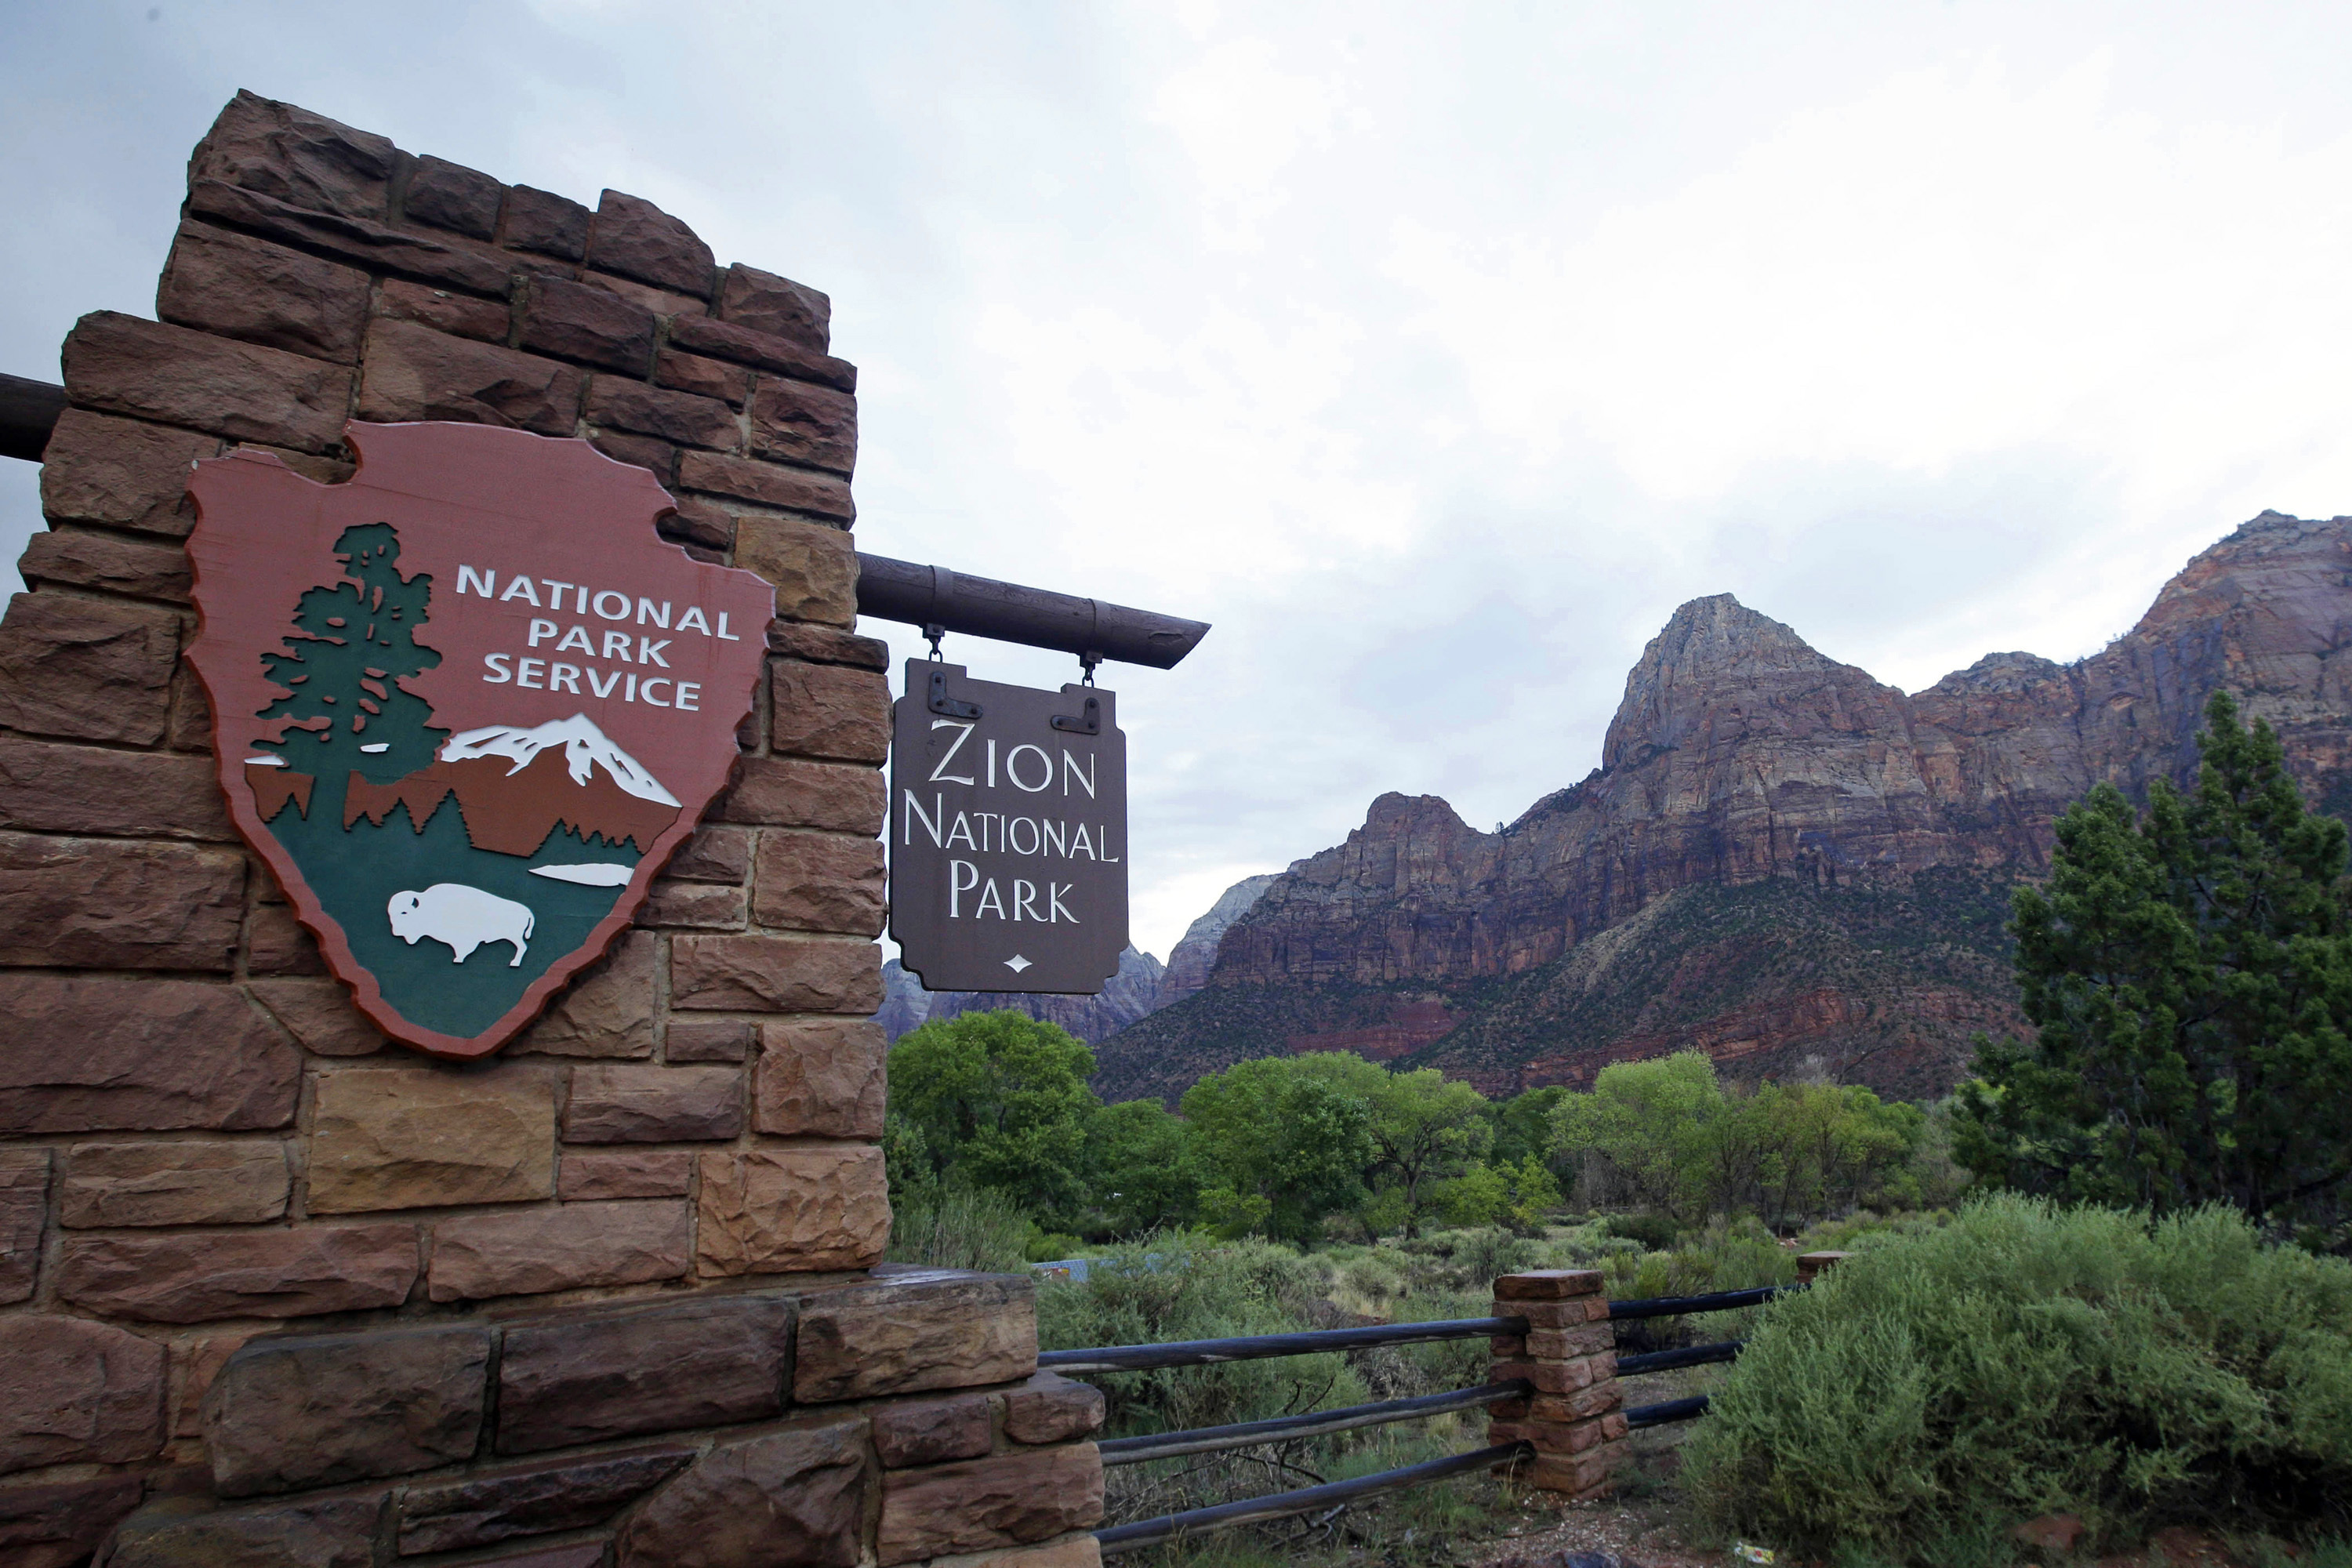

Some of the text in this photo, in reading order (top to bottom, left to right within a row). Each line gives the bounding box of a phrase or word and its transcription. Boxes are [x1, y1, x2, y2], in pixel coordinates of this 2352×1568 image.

[456, 564, 740, 641] NATIONAL
[528, 618, 673, 668] PARK
[482, 652, 701, 711] SERVICE
